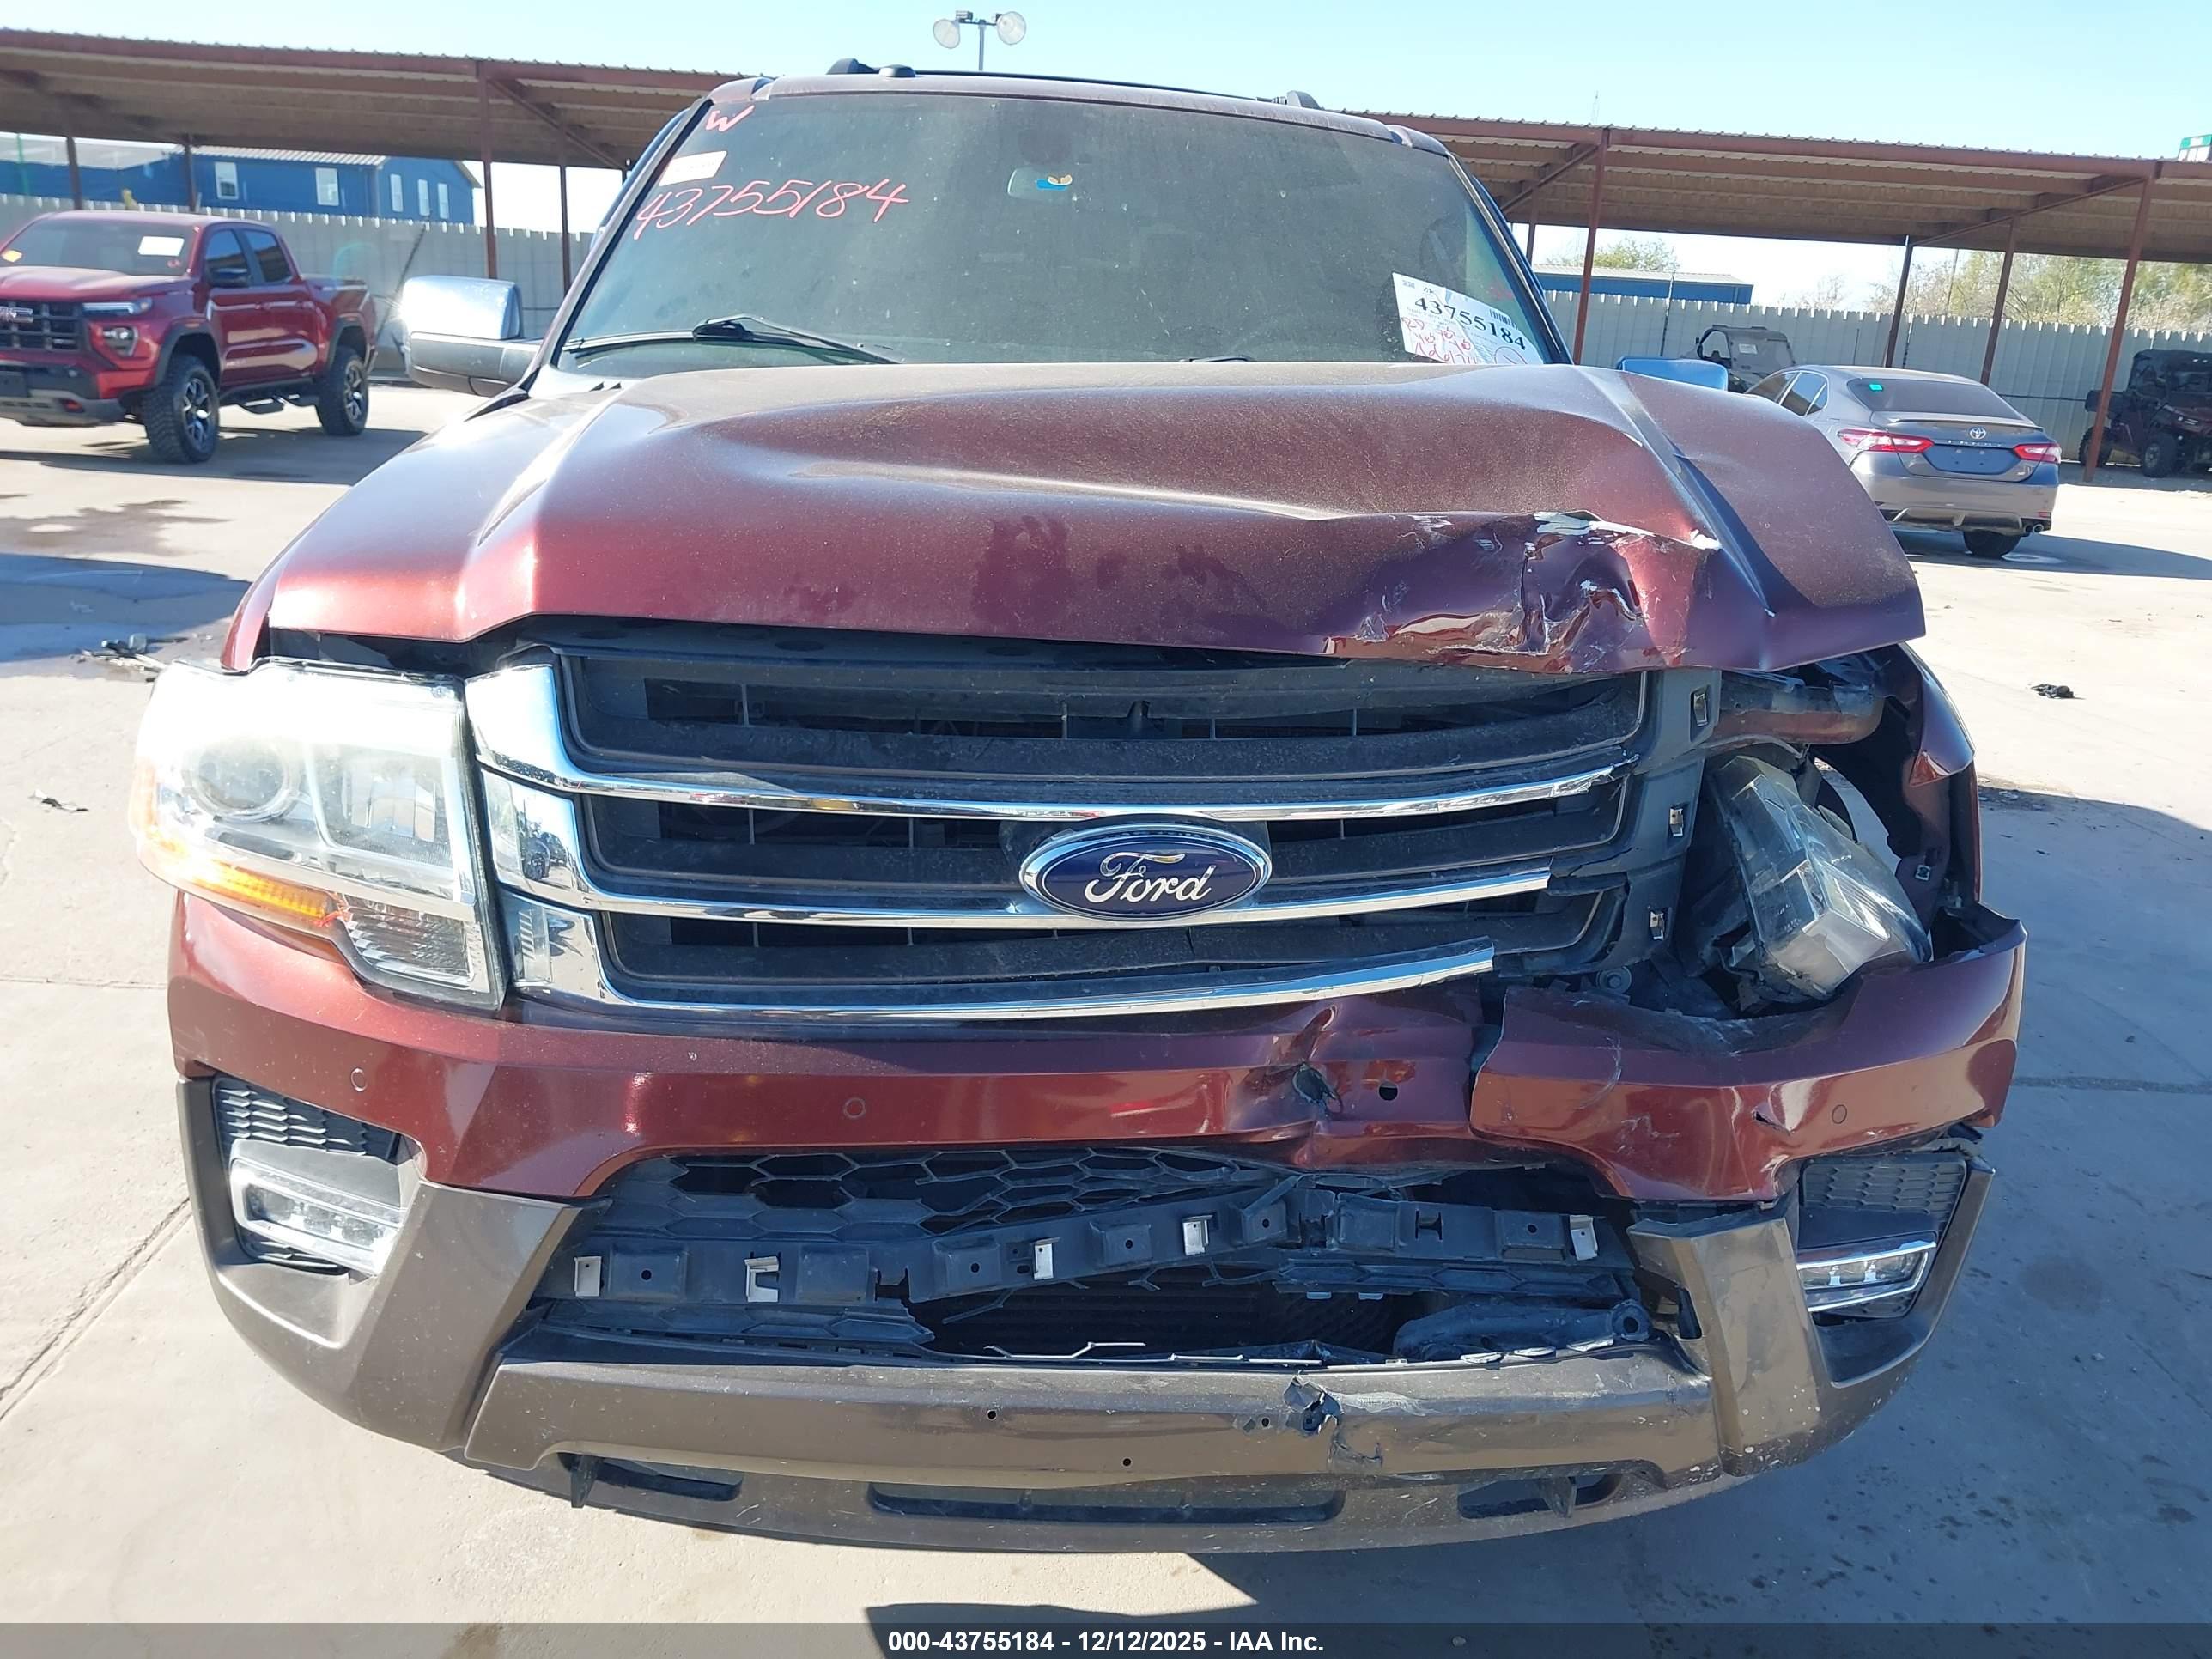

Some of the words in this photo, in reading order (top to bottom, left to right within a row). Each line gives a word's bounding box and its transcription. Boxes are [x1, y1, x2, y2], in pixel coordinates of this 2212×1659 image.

[705, 105, 755, 131] W
[632, 178, 910, 240] 43755184
[1414, 297, 1527, 351] 43755184
[1085, 852, 1217, 902] Ford
